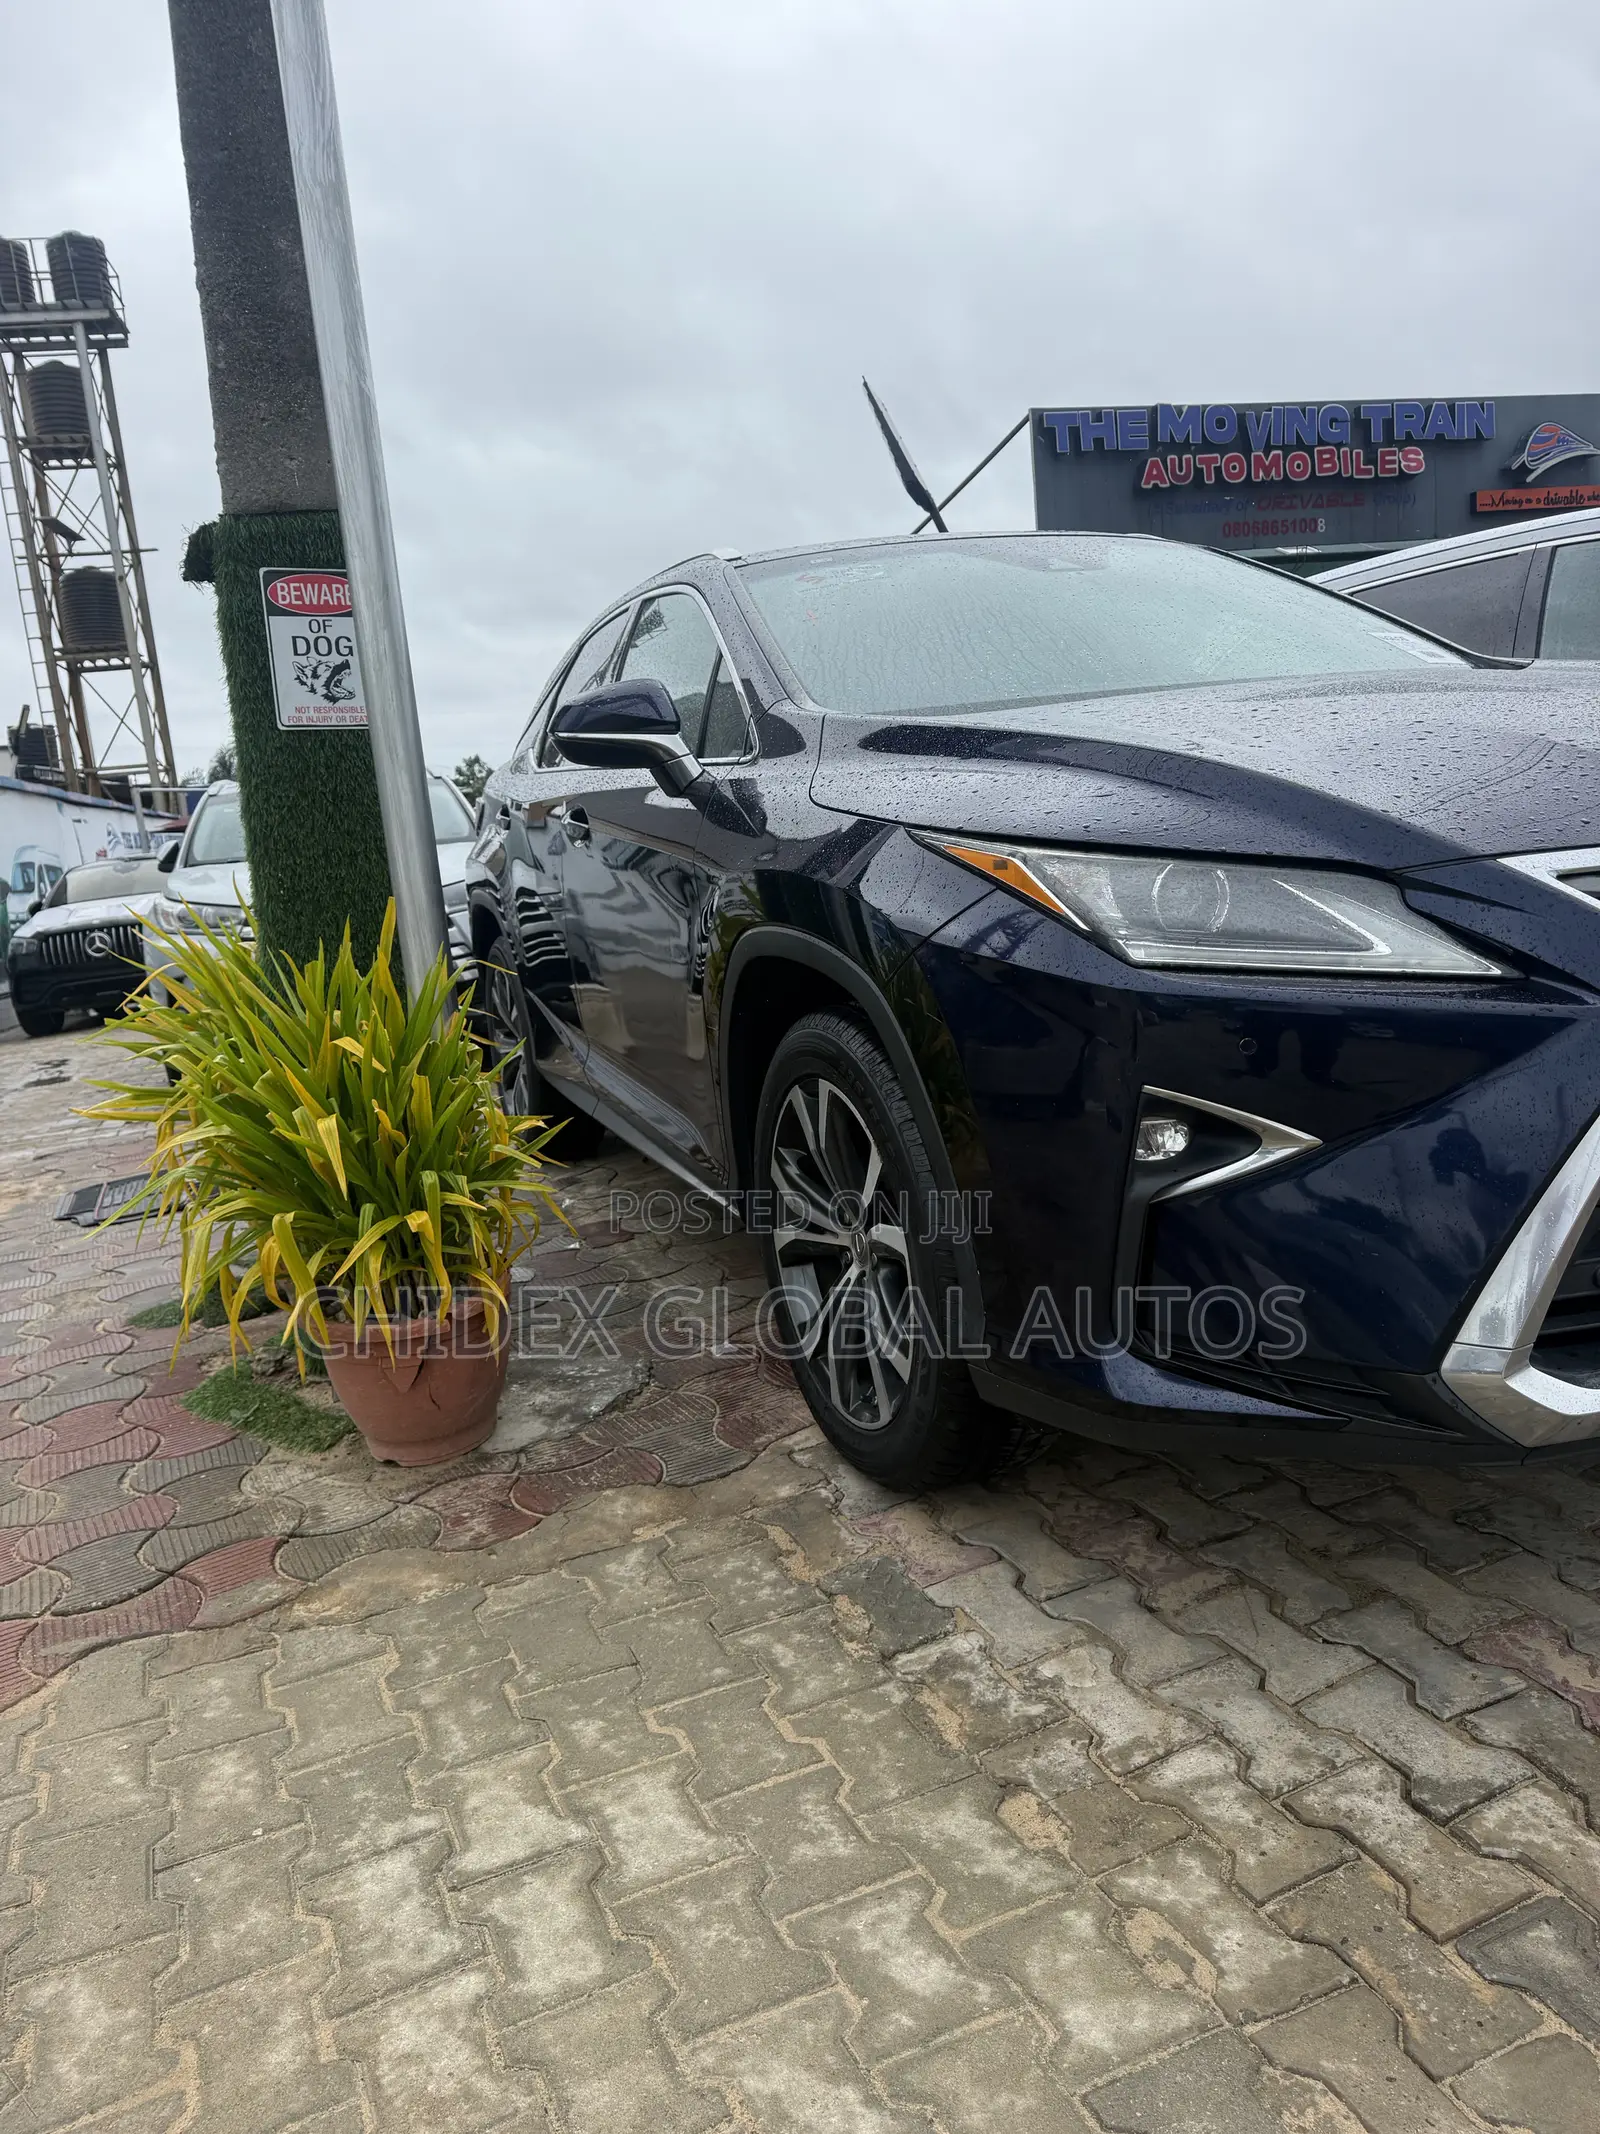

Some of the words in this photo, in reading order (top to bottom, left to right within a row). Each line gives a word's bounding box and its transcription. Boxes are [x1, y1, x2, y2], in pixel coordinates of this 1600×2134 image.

[1043, 409, 1149, 453] THE
[1157, 403, 1351, 452] MOVING
[1360, 401, 1496, 443] TRAIN
[1141, 446, 1425, 489] AUTOMOBILES
[1256, 492, 1366, 512] DRIVABLE
[1543, 489, 1586, 506] drivable
[308, 618, 333, 634] OF
[291, 635, 354, 657] DOG
[295, 706, 310, 714] NOT
[312, 705, 365, 714] RESPONSIBLE
[287, 715, 303, 724] FOR
[305, 715, 334, 724] INJURY
[335, 715, 347, 723] OR
[349, 715, 369, 724] DEAT
